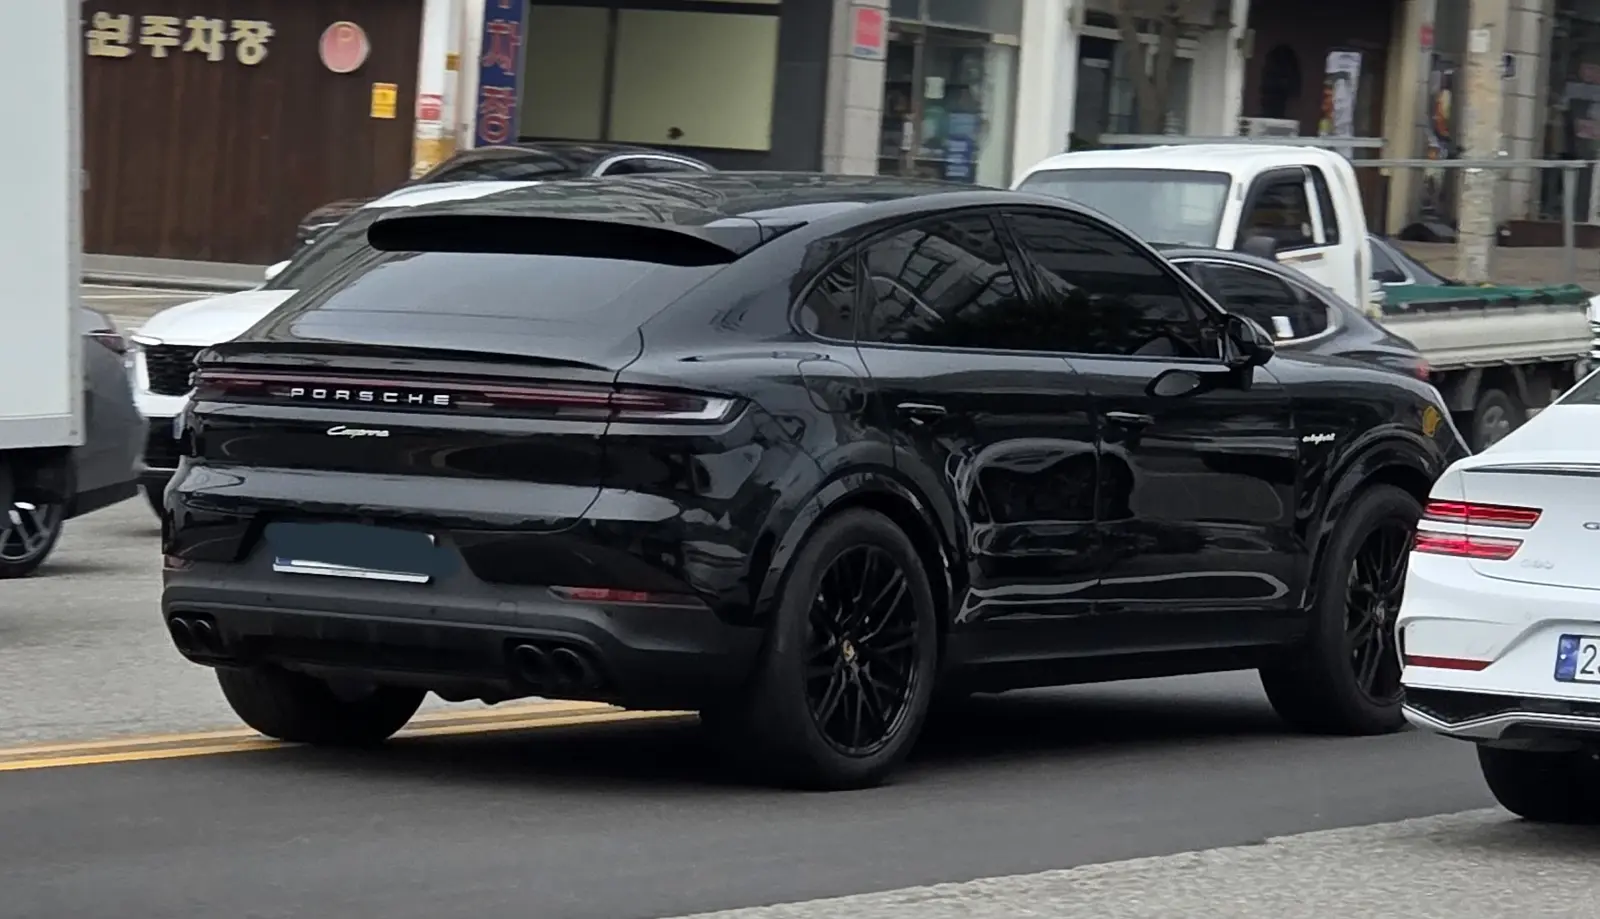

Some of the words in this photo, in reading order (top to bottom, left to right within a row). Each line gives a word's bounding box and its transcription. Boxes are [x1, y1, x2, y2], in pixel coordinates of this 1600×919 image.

[479, 0, 521, 143] 차장
[290, 388, 450, 406] PORSCHE
[1580, 644, 1600, 675] 2
